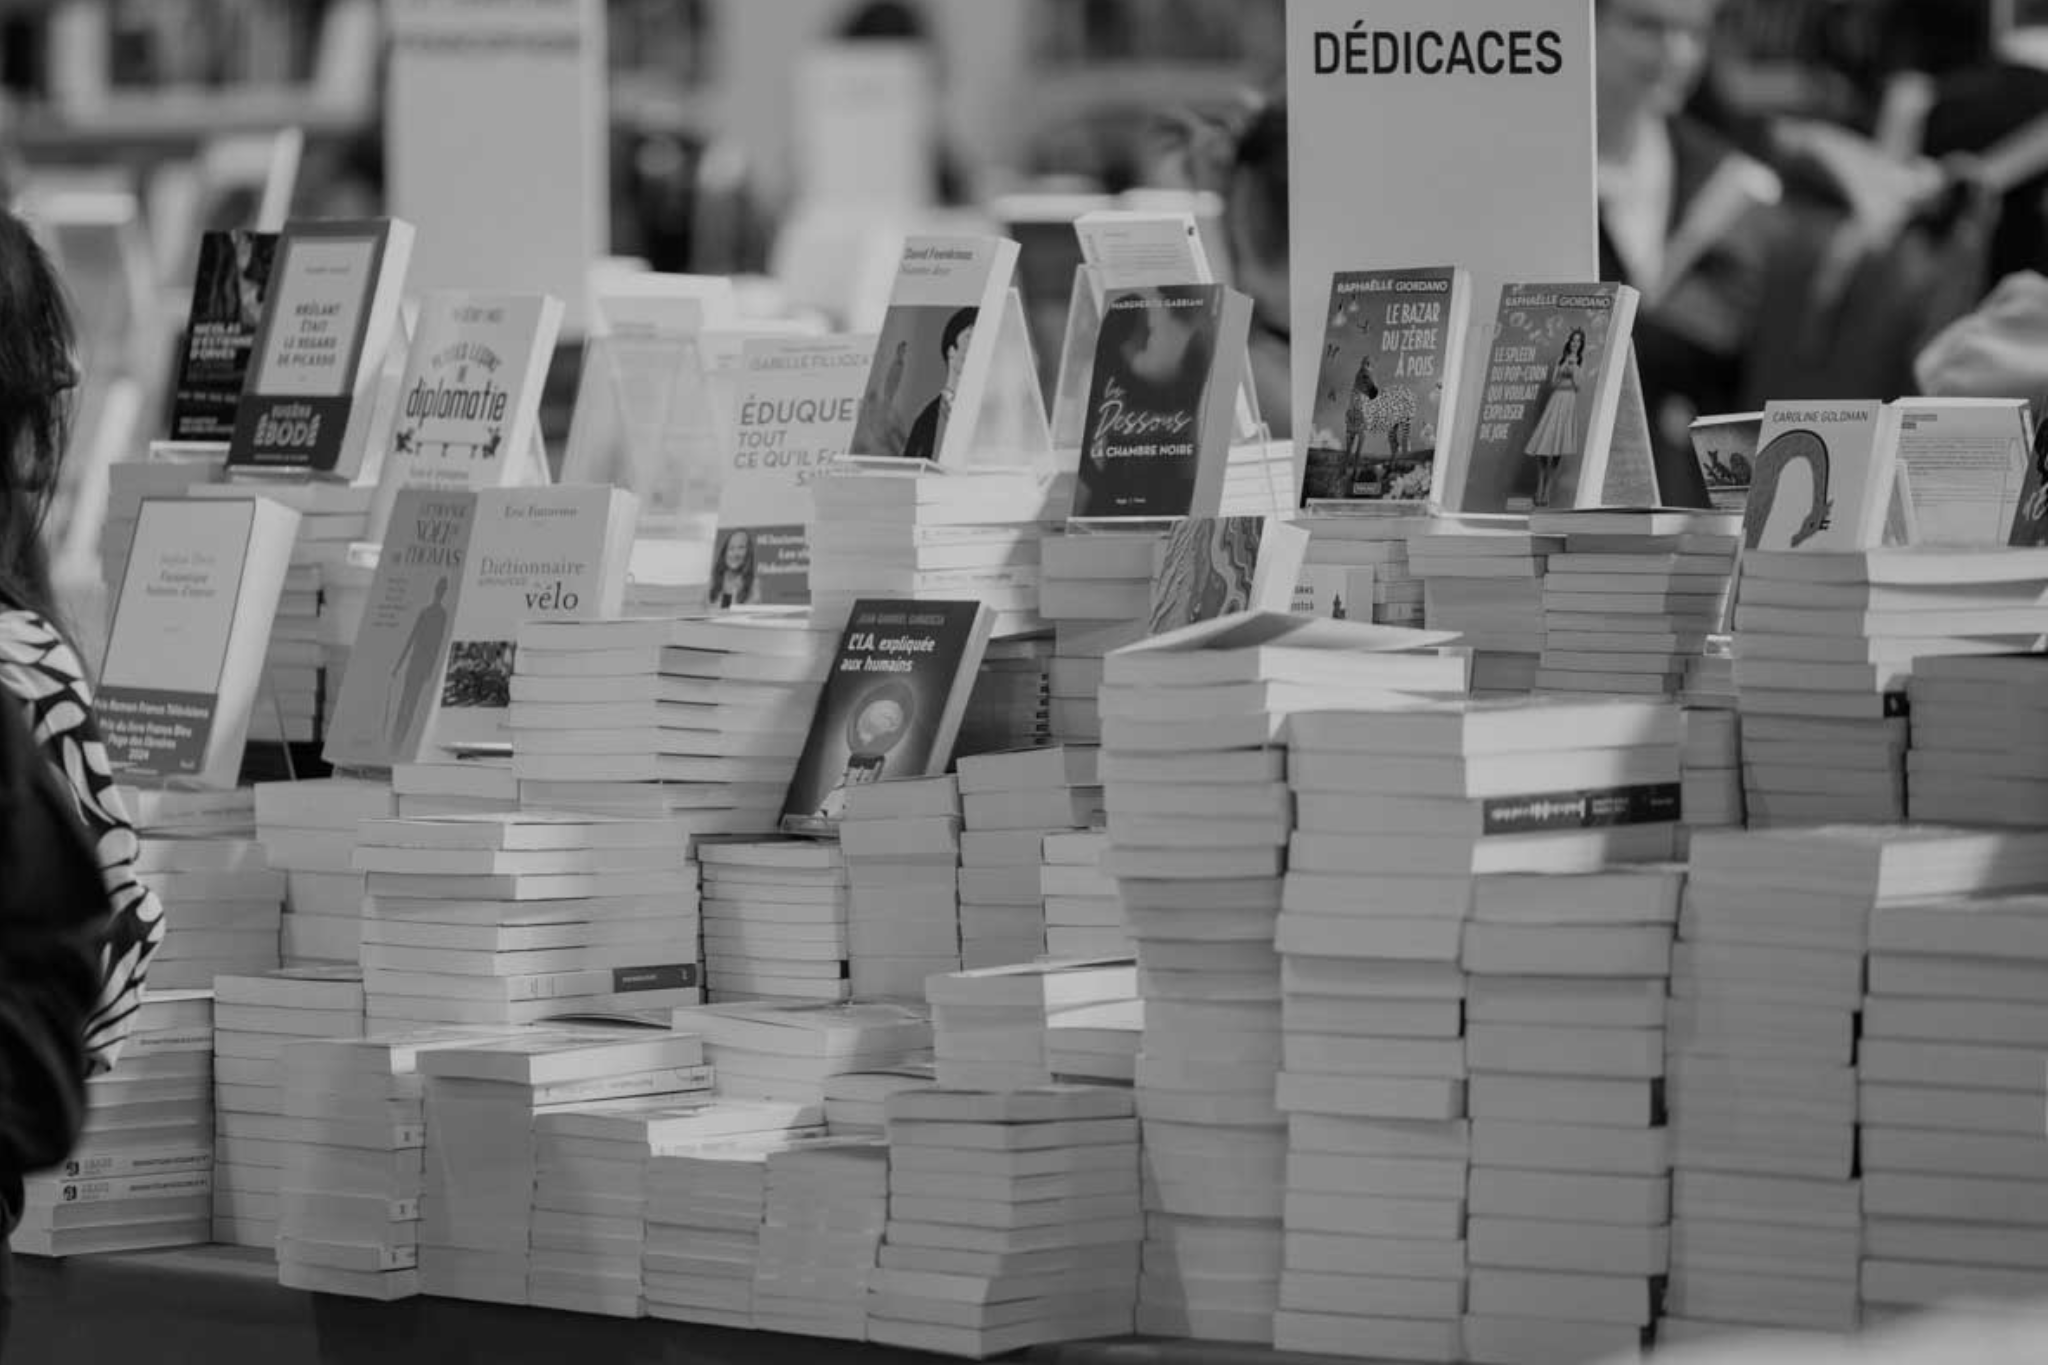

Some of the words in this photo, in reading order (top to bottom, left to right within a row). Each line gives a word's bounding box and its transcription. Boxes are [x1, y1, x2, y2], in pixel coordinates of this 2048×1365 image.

[1314, 19, 1562, 75] DÉDICACES
[1337, 279, 1393, 293] RAPHAËLLE
[1395, 280, 1448, 292] GIORDANO
[1558, 296, 1611, 308] GIORDANO
[1385, 303, 1400, 325] LE
[1401, 302, 1441, 324] BAZAR
[1382, 330, 1400, 351] DU
[1407, 355, 1435, 377] POIS
[406, 375, 508, 430] diplomatie
[740, 393, 855, 426] ÉDUQUE
[1772, 411, 1819, 423] CAROLINE
[1821, 410, 1869, 422] GOLDMAN
[738, 430, 788, 448] TOUT
[733, 451, 759, 469] CE
[763, 448, 813, 469] QU'IL
[1090, 446, 1105, 458] LA
[1106, 444, 1158, 457] CHAMBRE
[1160, 443, 1194, 456] NOIRE
[480, 555, 586, 578] Dictionnaire
[525, 581, 580, 612] vélo
[878, 634, 936, 655] expliquée
[840, 657, 863, 672] aux
[863, 655, 913, 673] humains
